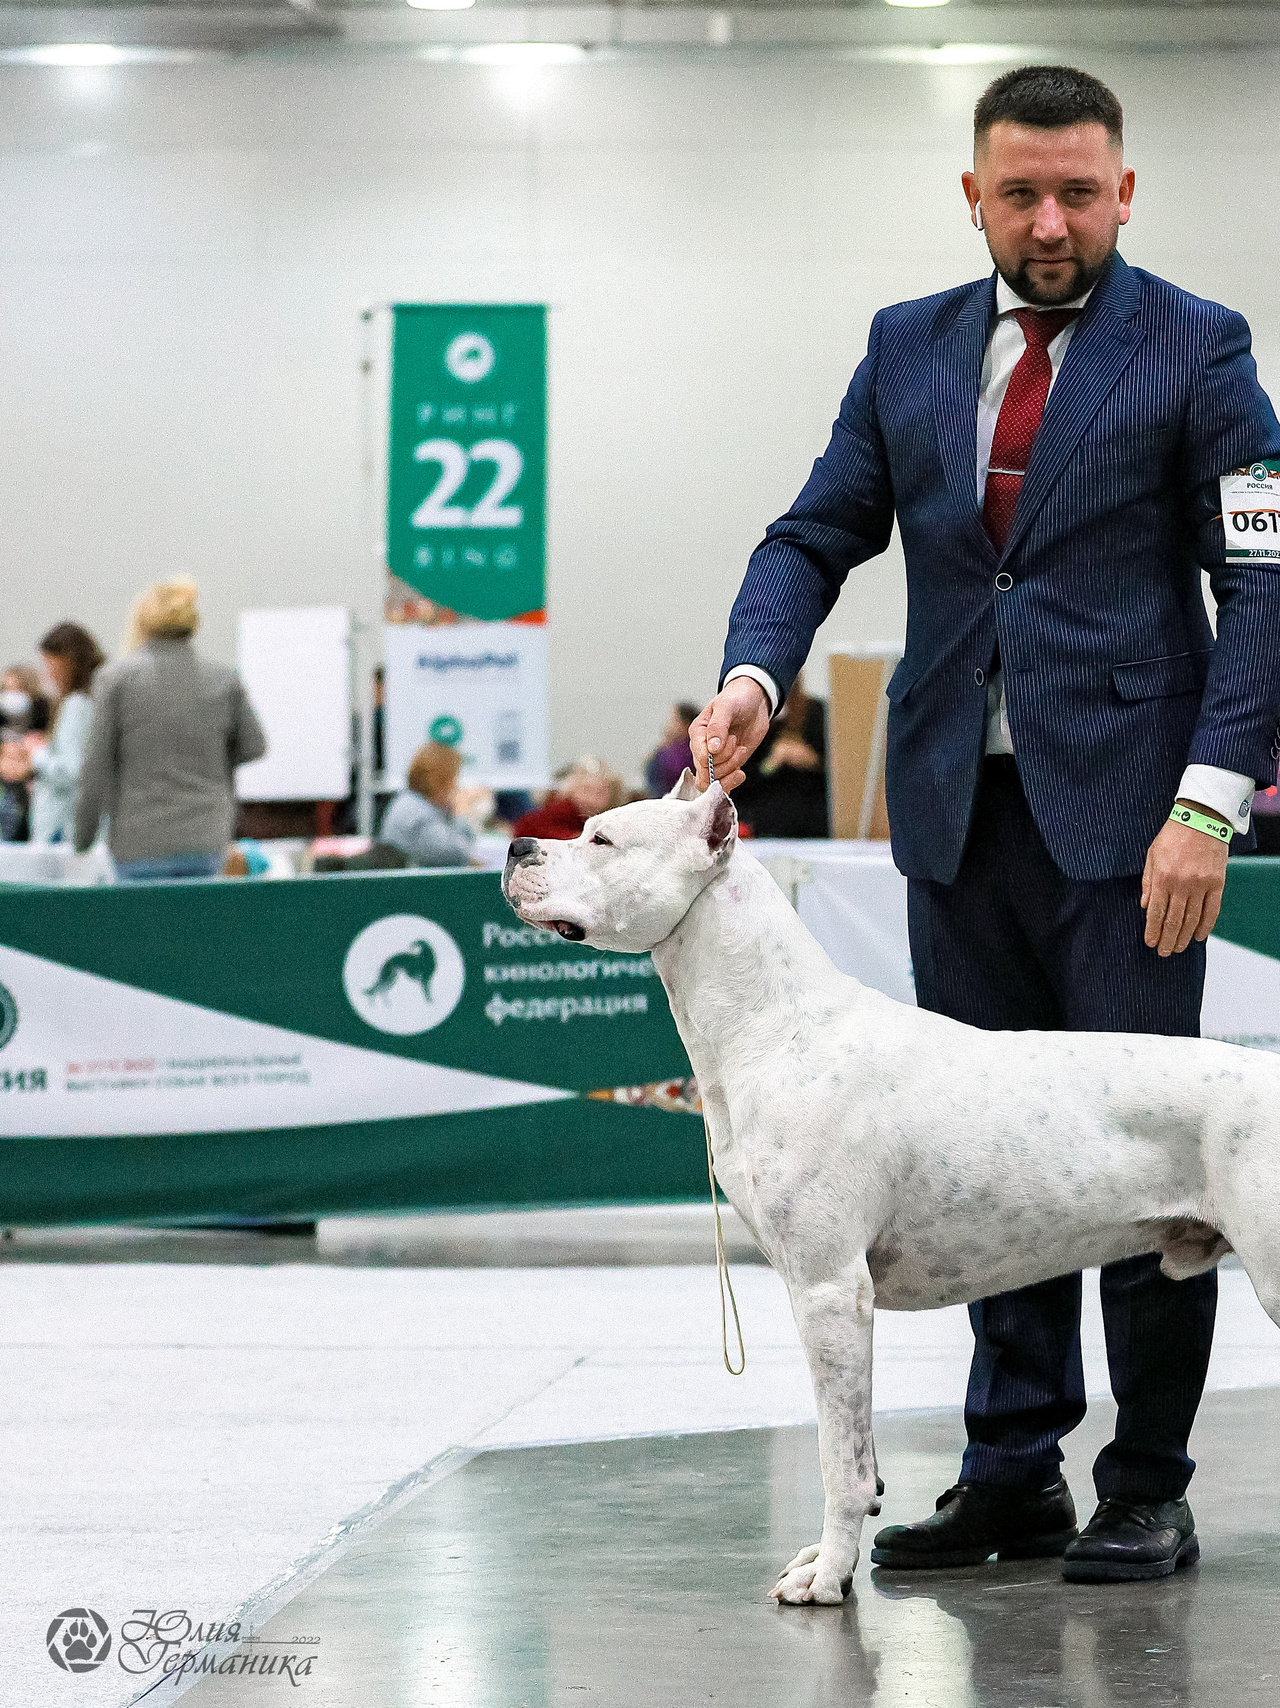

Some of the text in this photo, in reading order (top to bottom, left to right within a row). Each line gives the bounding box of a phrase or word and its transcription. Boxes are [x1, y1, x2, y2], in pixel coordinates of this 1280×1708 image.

[410, 438, 524, 528] 22
[1246, 482, 1273, 490] РОССИЯ
[0, 1067, 48, 1092] ИЯ
